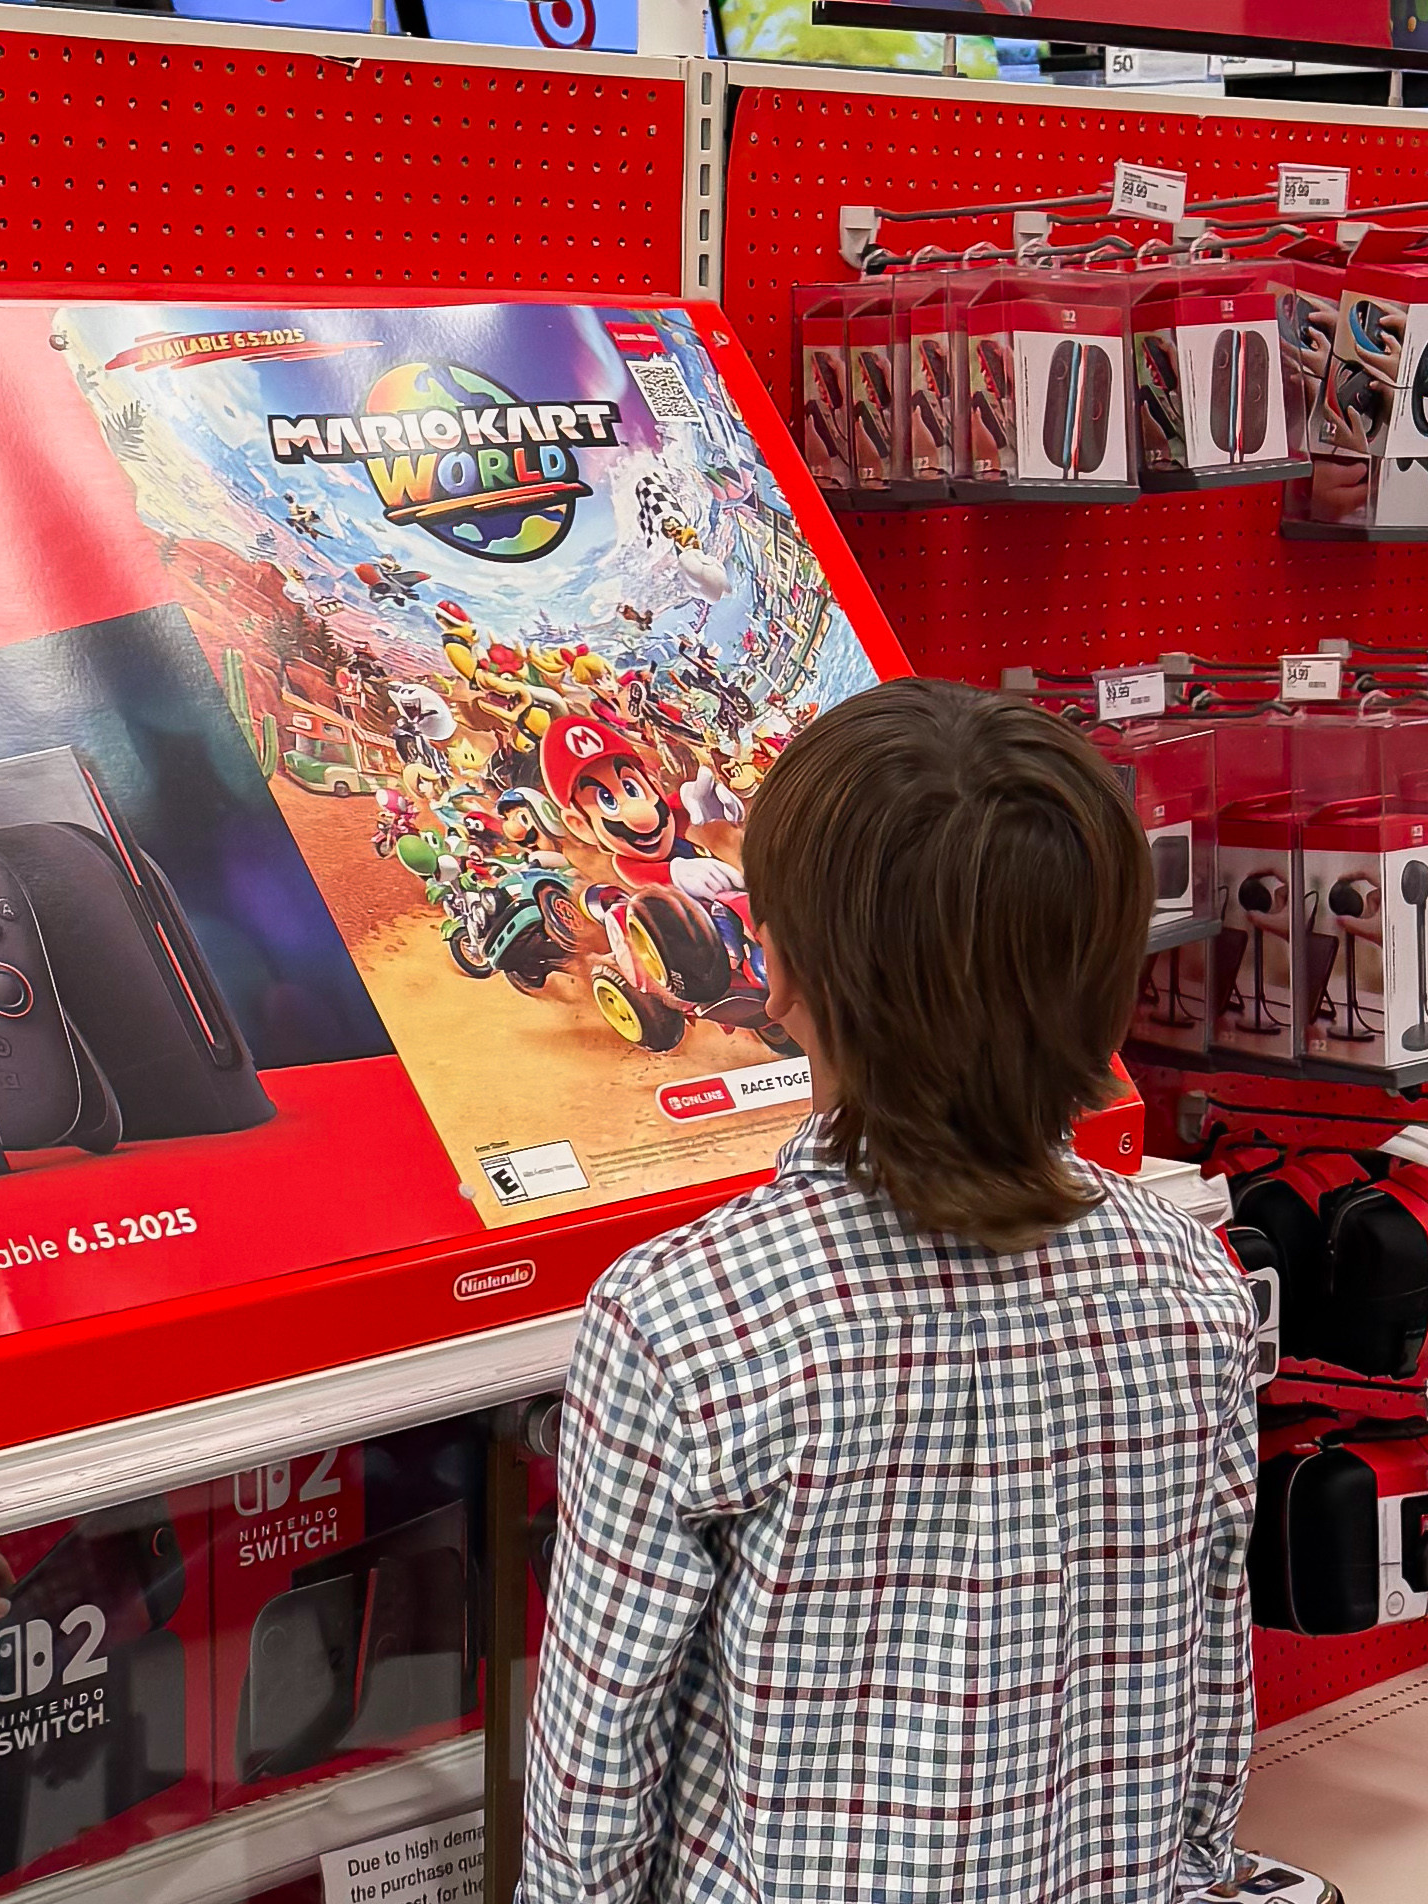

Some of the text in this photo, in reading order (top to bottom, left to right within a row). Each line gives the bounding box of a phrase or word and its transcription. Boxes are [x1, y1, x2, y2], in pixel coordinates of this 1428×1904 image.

[141, 328, 306, 364] AVAILABLE 6.5.2025
[368, 446, 566, 506] WORLD
[681, 1089, 725, 1108] ONLINE
[740, 1077, 775, 1096] RACE
[491, 1167, 520, 1196] E
[67, 1207, 198, 1254] 6.5.2025
[460, 1267, 530, 1296] Nintendo
[239, 1507, 338, 1543] NINTENDO
[239, 1521, 338, 1567] SWITCH
[60, 1604, 108, 1686] 2
[348, 1855, 380, 1878] Due
[385, 1849, 400, 1866] to
[405, 1835, 439, 1860] high
[350, 1884, 376, 1904] the
[381, 1862, 453, 1896] purchase
[437, 1886, 458, 1904] for
